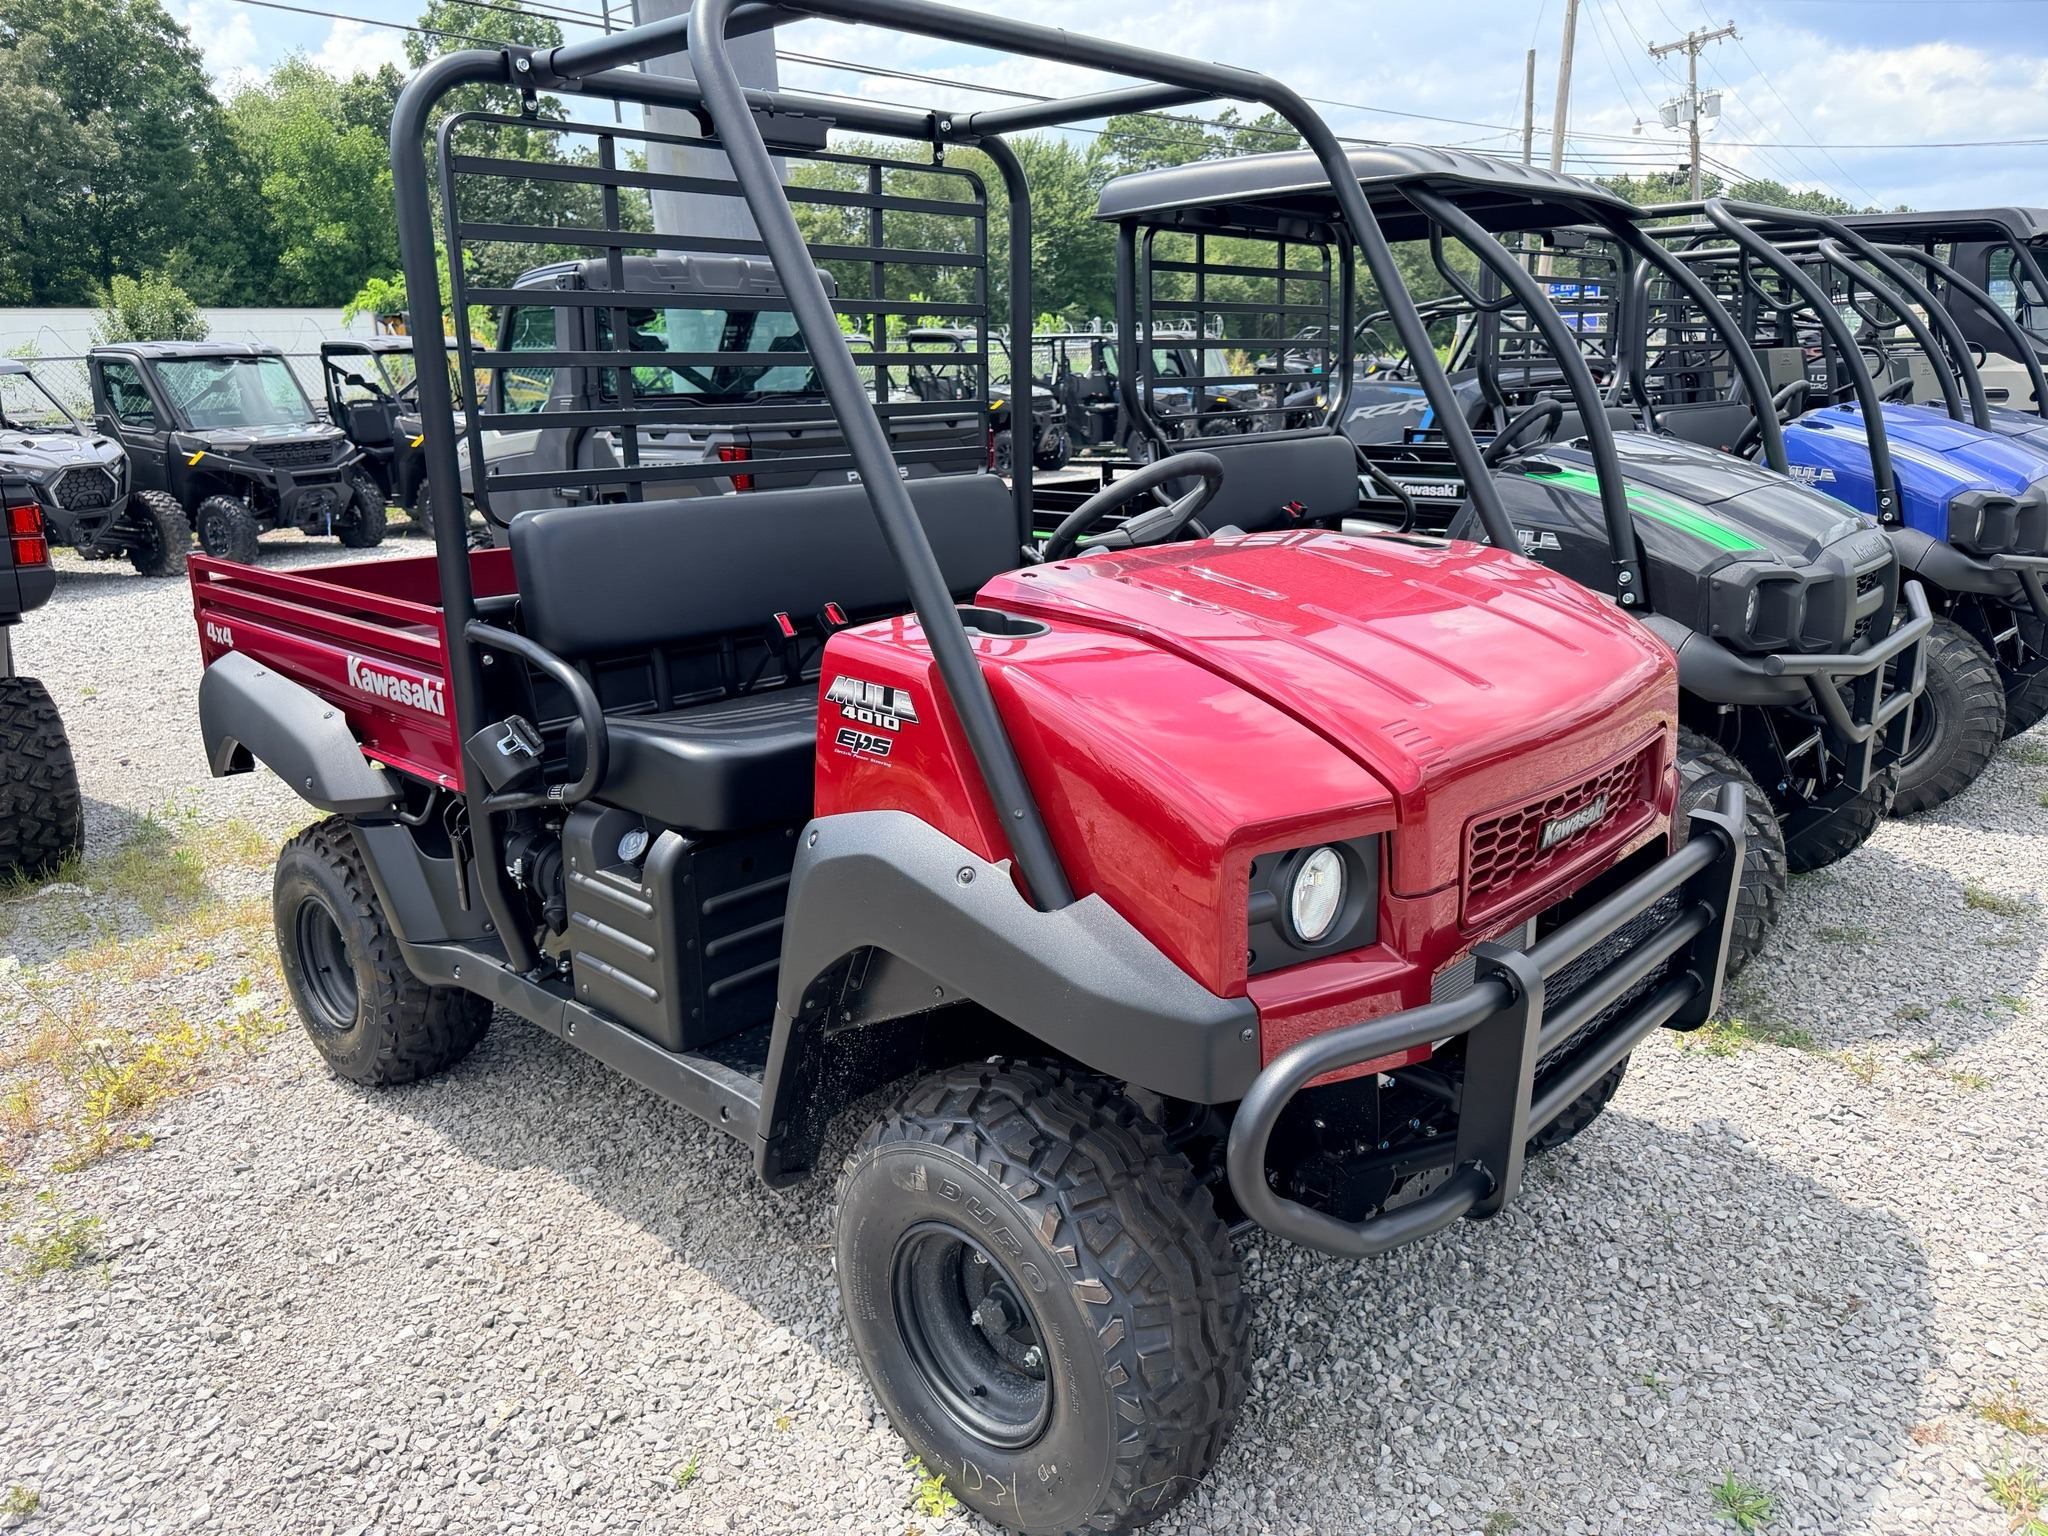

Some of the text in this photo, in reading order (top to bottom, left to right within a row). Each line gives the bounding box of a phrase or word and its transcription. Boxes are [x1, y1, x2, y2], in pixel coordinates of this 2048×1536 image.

[1346, 398, 1429, 423] RZR
[1395, 482, 1458, 497] Kawasaki
[206, 621, 235, 648] 4x4
[346, 654, 446, 718] Kawasaki
[824, 674, 920, 725] MULE
[841, 705, 901, 732] 4010
[835, 727, 893, 757] EPS
[1541, 793, 1609, 849] Kawasaki
[936, 1178, 1048, 1293] DURO
